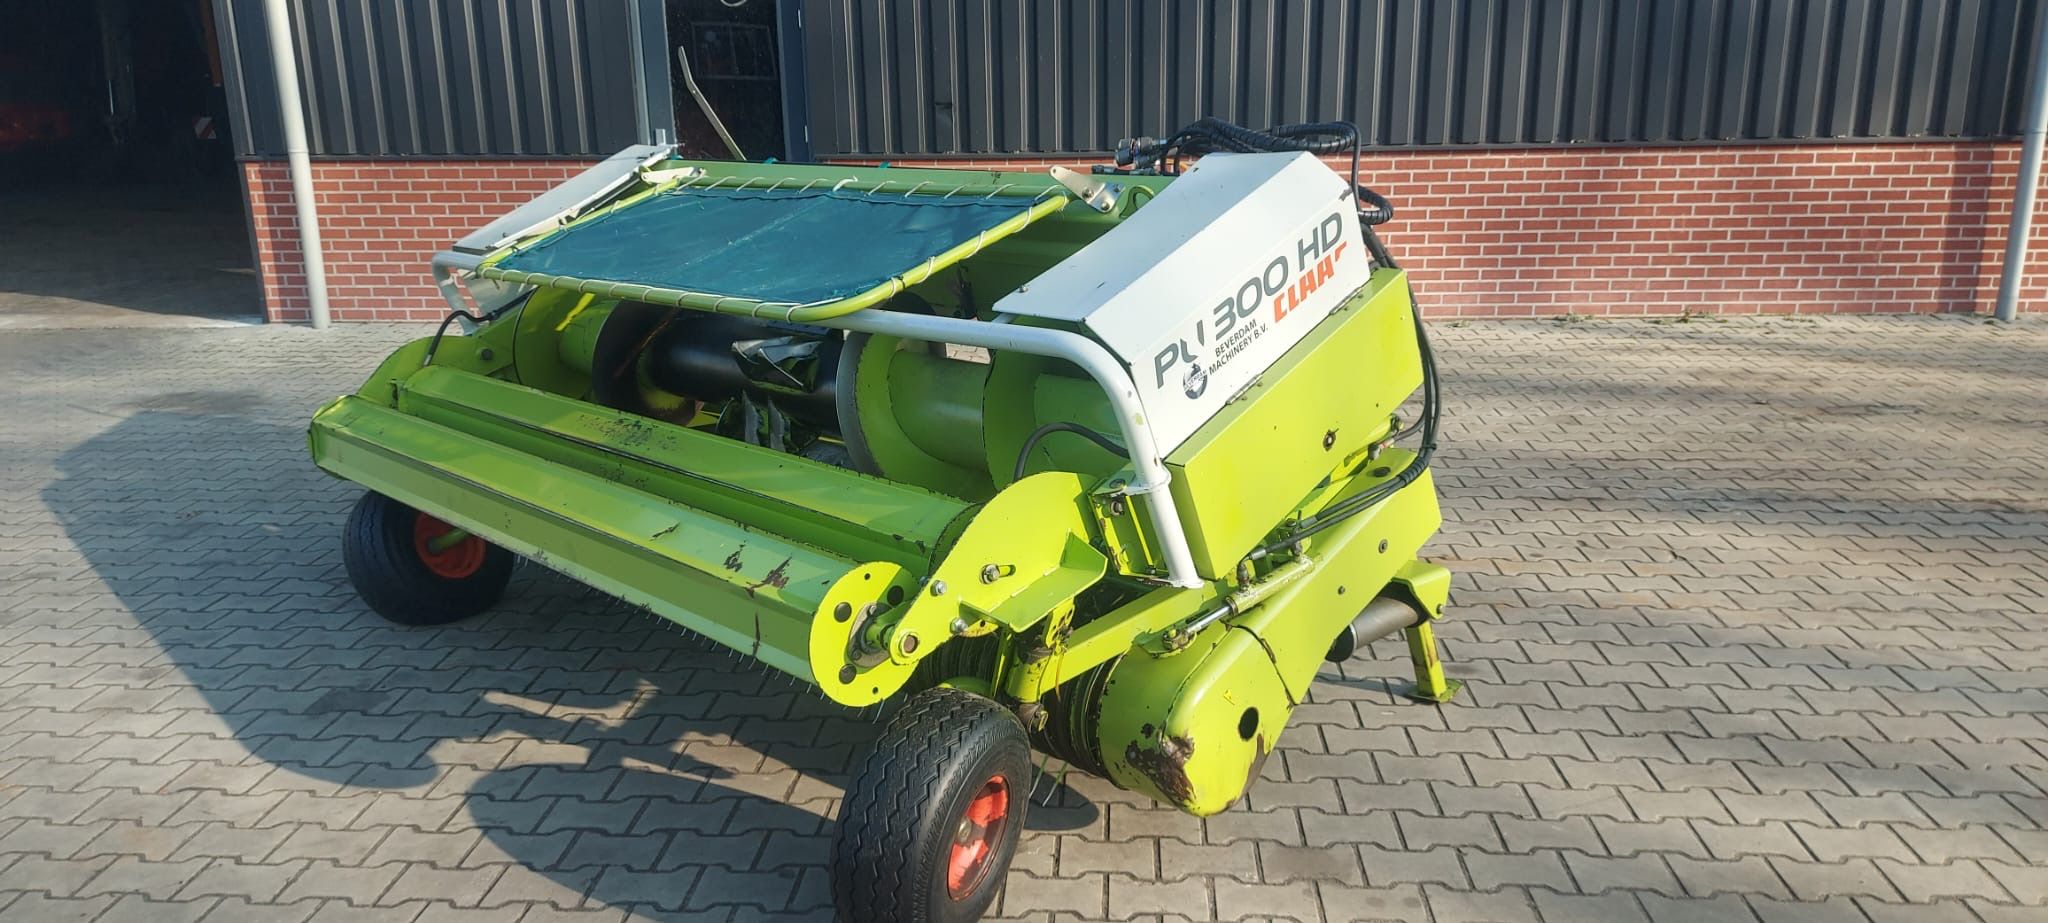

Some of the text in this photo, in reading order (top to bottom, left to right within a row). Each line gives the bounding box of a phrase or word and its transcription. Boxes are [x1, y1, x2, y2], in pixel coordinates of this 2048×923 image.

[1213, 255, 1288, 341] 300
[1297, 212, 1343, 272] HD
[1209, 323, 1269, 375] MACHINERY B.V.
[1215, 318, 1257, 357] BEVERDAM
